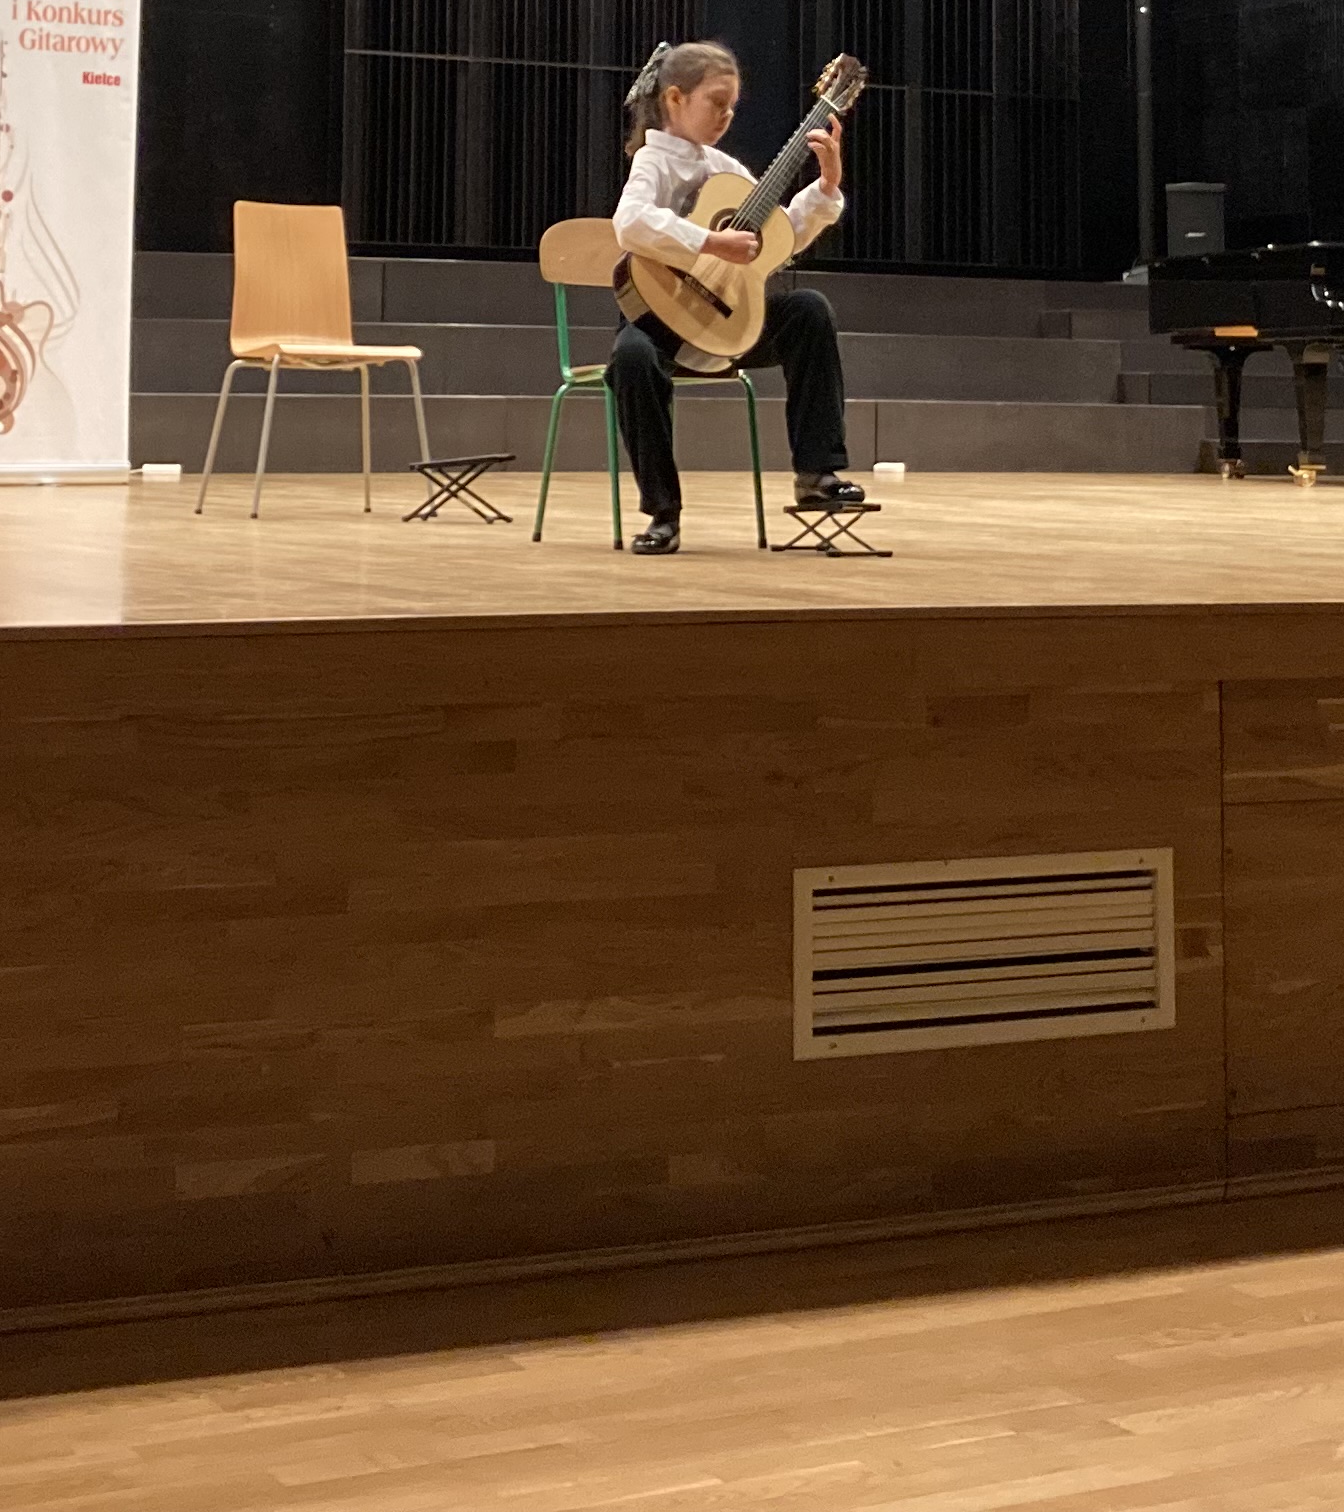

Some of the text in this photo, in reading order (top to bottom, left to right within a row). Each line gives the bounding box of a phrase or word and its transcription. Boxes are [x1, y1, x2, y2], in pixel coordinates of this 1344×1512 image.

[26, 0, 125, 27] Konkurs
[18, 27, 125, 60] Gitarowy
[82, 71, 121, 87] Kielce
